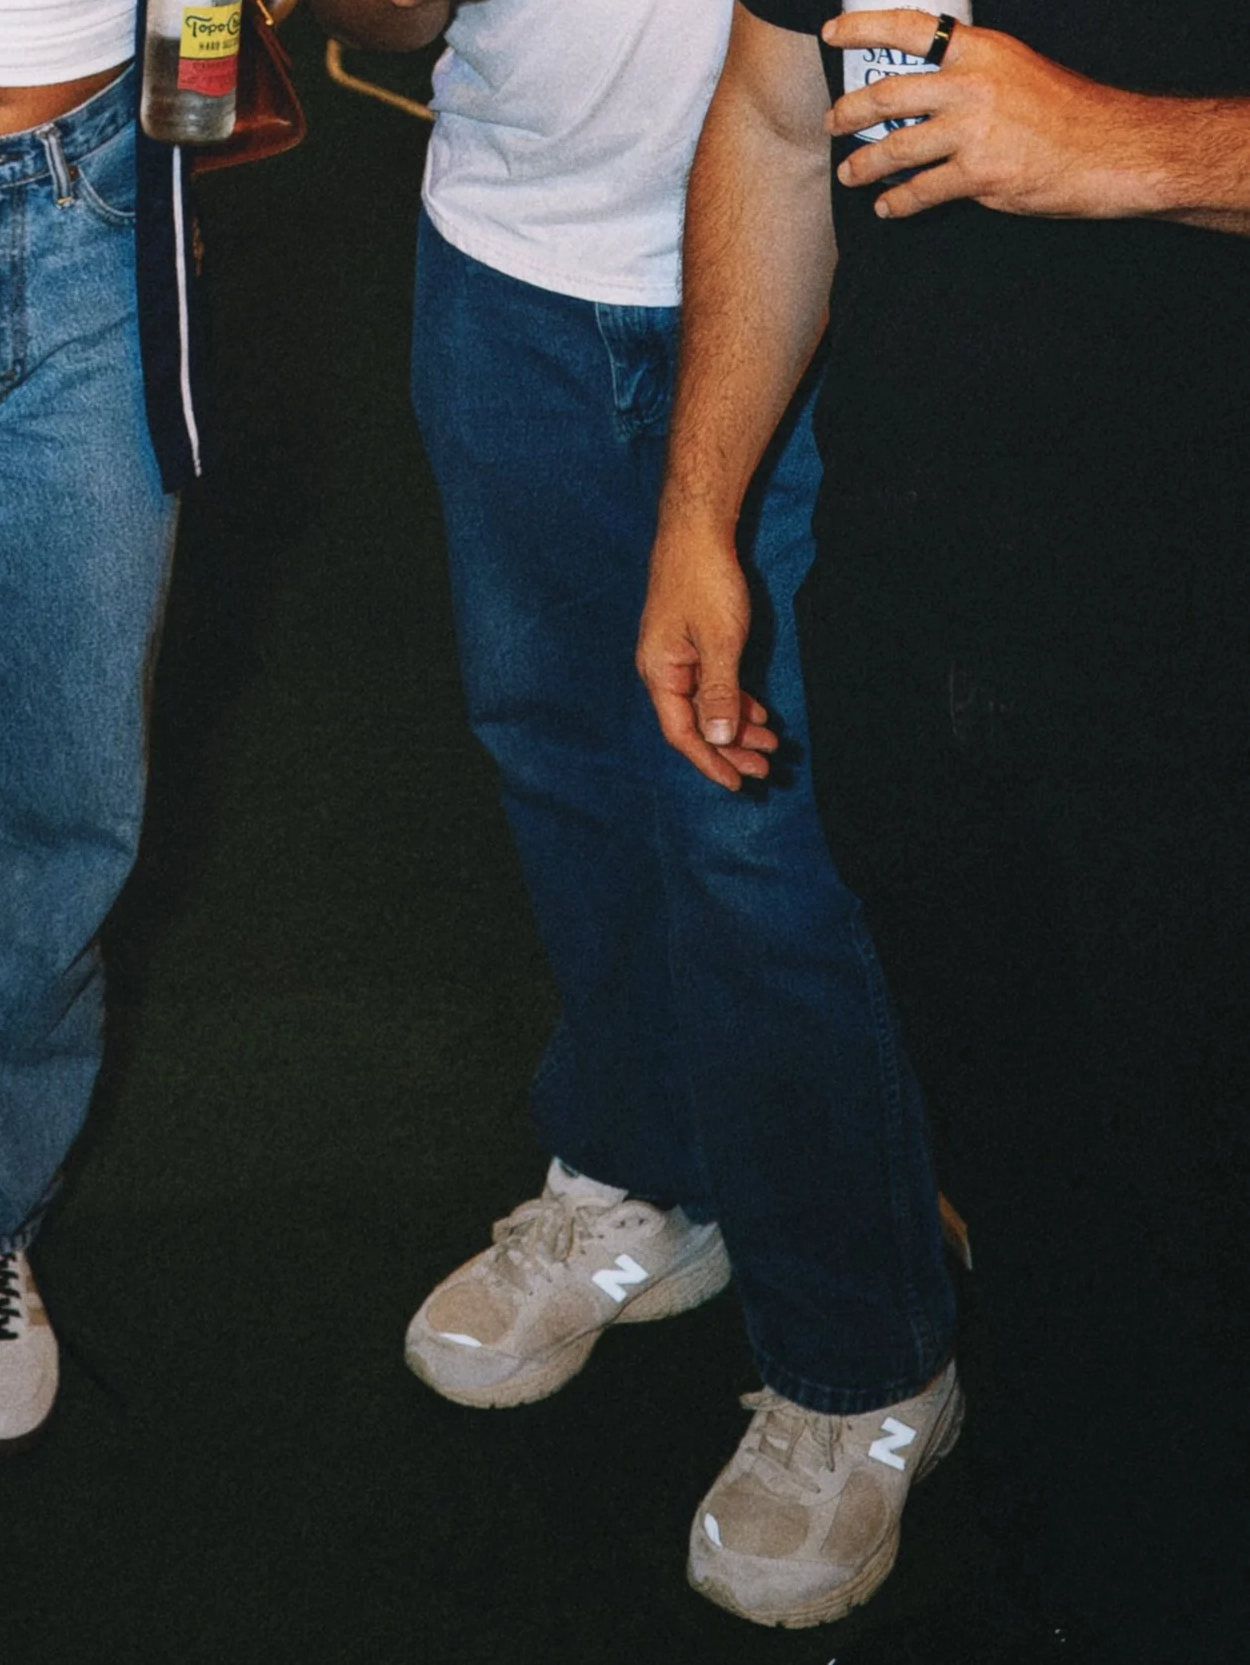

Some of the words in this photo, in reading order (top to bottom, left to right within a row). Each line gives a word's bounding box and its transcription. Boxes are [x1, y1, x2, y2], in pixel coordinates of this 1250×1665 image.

[185, 15, 227, 38] Topo
[592, 1253, 650, 1303] N
[868, 1416, 917, 1471] N
